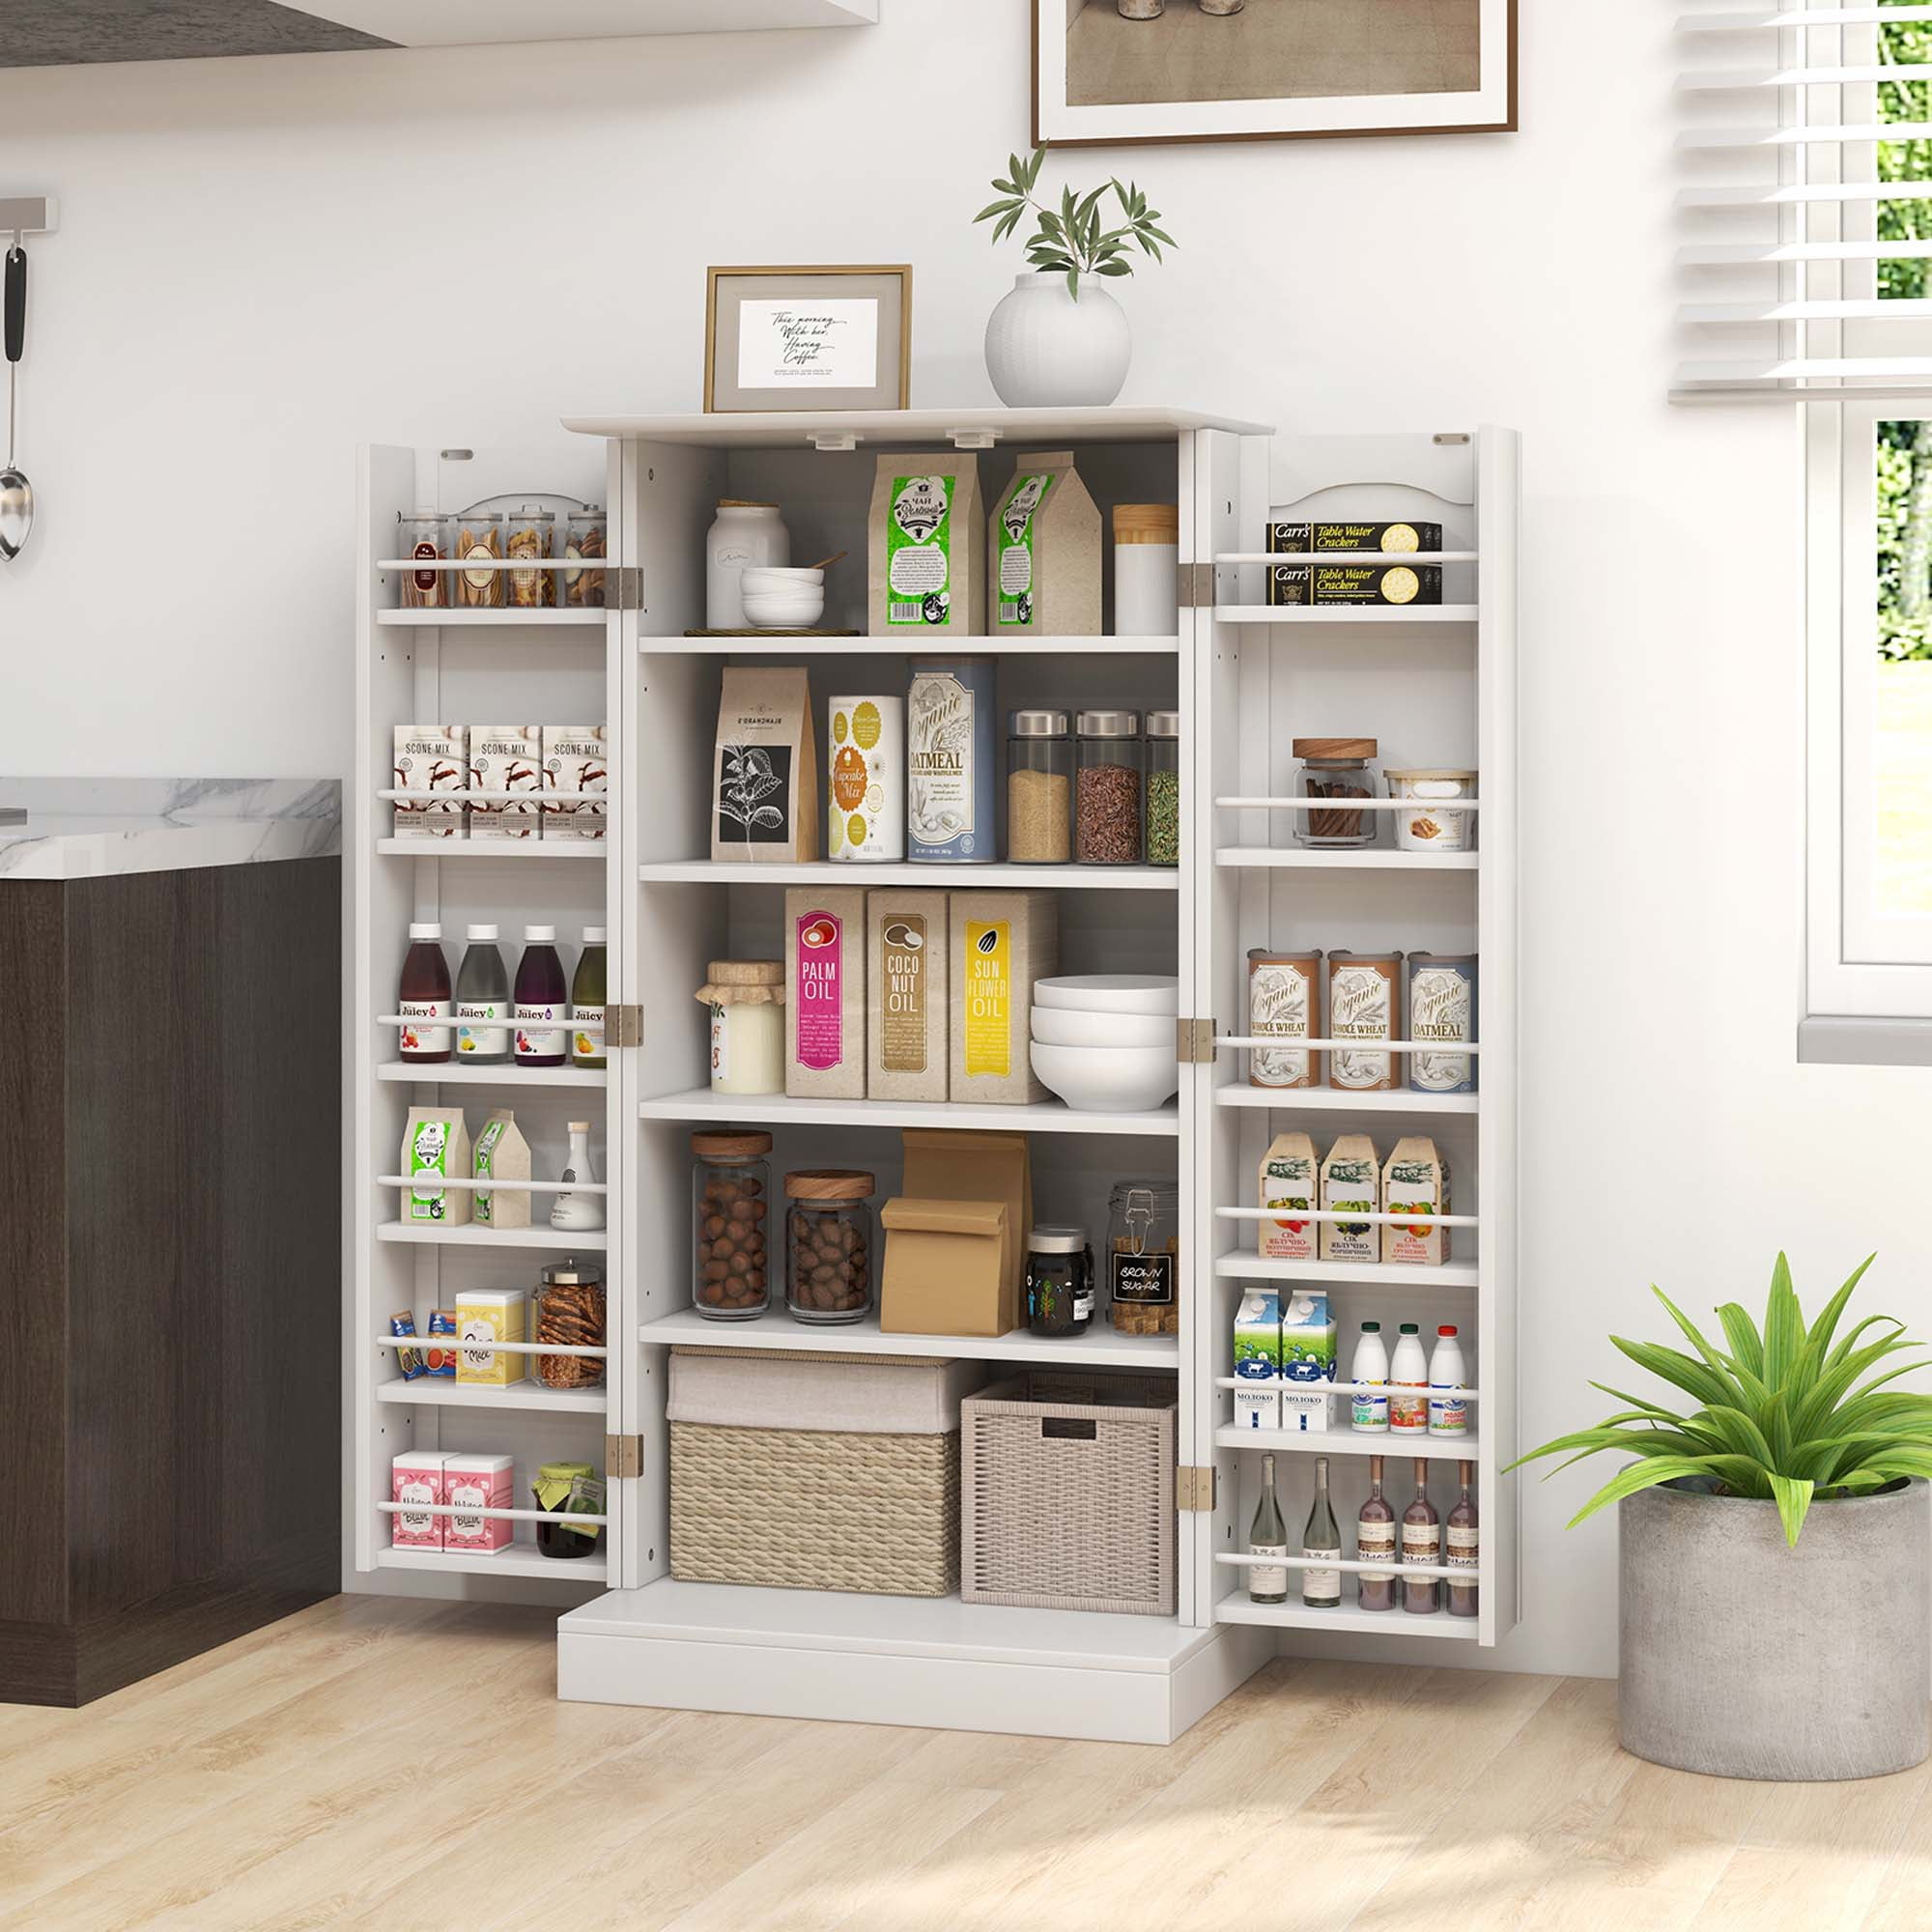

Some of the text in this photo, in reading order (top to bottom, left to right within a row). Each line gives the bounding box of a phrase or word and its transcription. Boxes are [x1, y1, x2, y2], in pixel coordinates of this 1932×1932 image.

[771, 311, 795, 326] This
[783, 336, 835, 354] Having
[1275, 524, 1311, 538] Carr's
[1317, 526, 1374, 537] Table Water
[1317, 537, 1359, 548] Crackers
[1275, 566, 1311, 581] Carr's
[1317, 568, 1374, 580] Table Water
[1317, 580, 1359, 590] Crackers
[405, 743, 450, 754] SCONE MIX
[481, 743, 526, 754] SCONE MIX
[554, 744, 600, 755] SCONE MIX
[803, 962, 836, 980] PALM
[888, 955, 919, 975] COCO
[975, 960, 999, 978] SUN
[805, 980, 834, 1000] OIL
[892, 975, 916, 993] NUT
[968, 979, 1006, 998] FLOWER
[889, 993, 918, 1012] OIL
[973, 998, 1002, 1017] OIL
[402, 1006, 429, 1017] Juicy
[460, 1008, 487, 1018] Juicy
[517, 1009, 544, 1020] Juicy
[576, 1010, 603, 1021] Juicy
[1276, 1022, 1305, 1033] WHEAT
[1357, 1024, 1387, 1034] WHEAT
[1414, 1023, 1463, 1037] OATMEAL
[1120, 1266, 1164, 1278] BROWN
[1121, 1280, 1161, 1292] SUGAR
[1236, 1393, 1273, 1402] МОЛОКО
[1285, 1396, 1321, 1405] МОЛОКО
